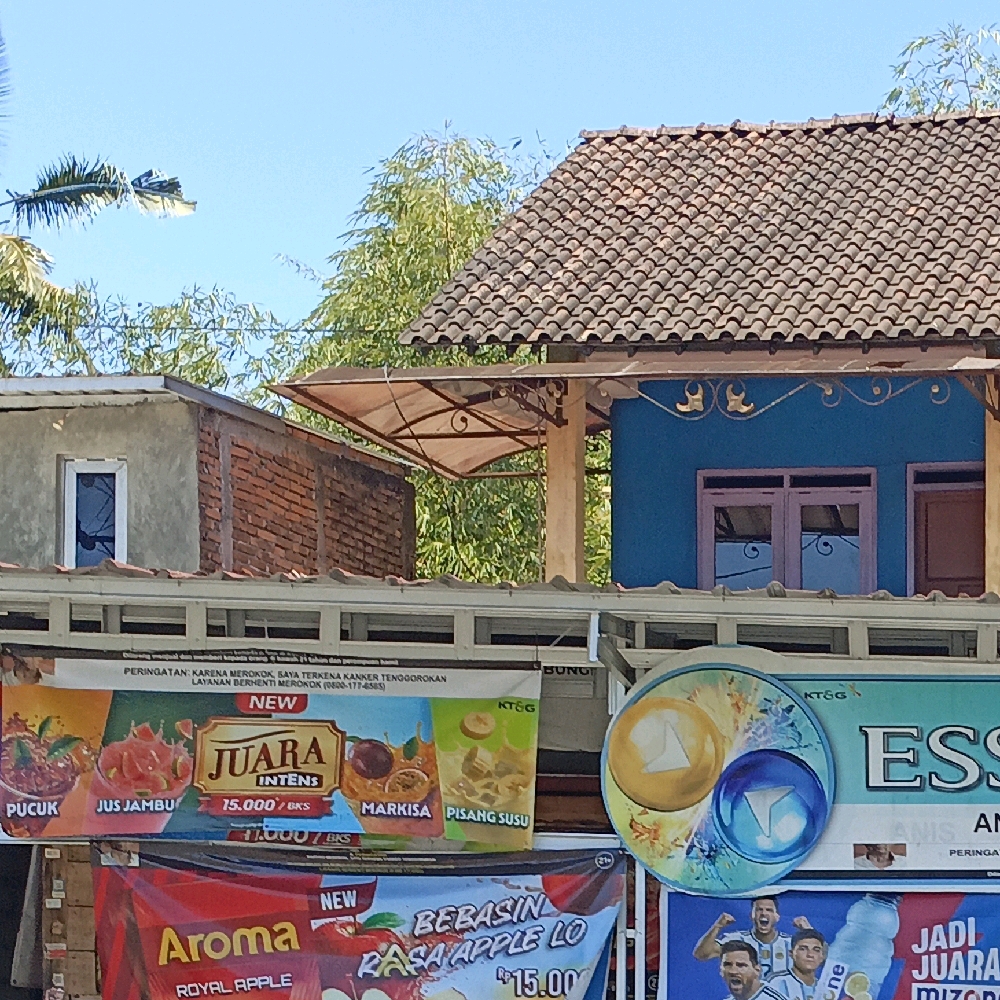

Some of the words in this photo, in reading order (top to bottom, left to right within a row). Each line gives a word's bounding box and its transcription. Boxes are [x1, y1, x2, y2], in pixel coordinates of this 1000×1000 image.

[123, 667, 191, 677] PERINGATAN:
[192, 669, 228, 678] KARENA
[277, 671, 300, 679] SAYA
[301, 671, 342, 681] TERKENA
[343, 673, 379, 682] KANKER
[380, 673, 447, 684] TENGGOROKAN
[191, 678, 231, 687] LAYANAN
[233, 679, 277, 688] BERHENTI
[278, 680, 322, 689] MEROKOK
[249, 695, 298, 710] NEW
[804, 690, 847, 701] KT&G
[498, 701, 536, 713] KT&G
[208, 736, 326, 781] JUARA
[258, 773, 319, 787] INTENS
[6, 801, 58, 818] PUCUK
[97, 800, 121, 812] JUS
[123, 799, 175, 812] JAMBU
[287, 802, 311, 811] BKS
[361, 802, 432, 818] MARKISA
[446, 806, 496, 823] PISANG
[499, 813, 529, 828] SUSU
[320, 890, 357, 911] NEW
[413, 892, 548, 937] BEBASIN
[158, 921, 300, 966] Aroma
[449, 925, 545, 967] APPLE
[548, 918, 588, 948] LO
[911, 917, 976, 954] JADI
[176, 980, 233, 998] ROYAL
[234, 973, 293, 992] APPLE
